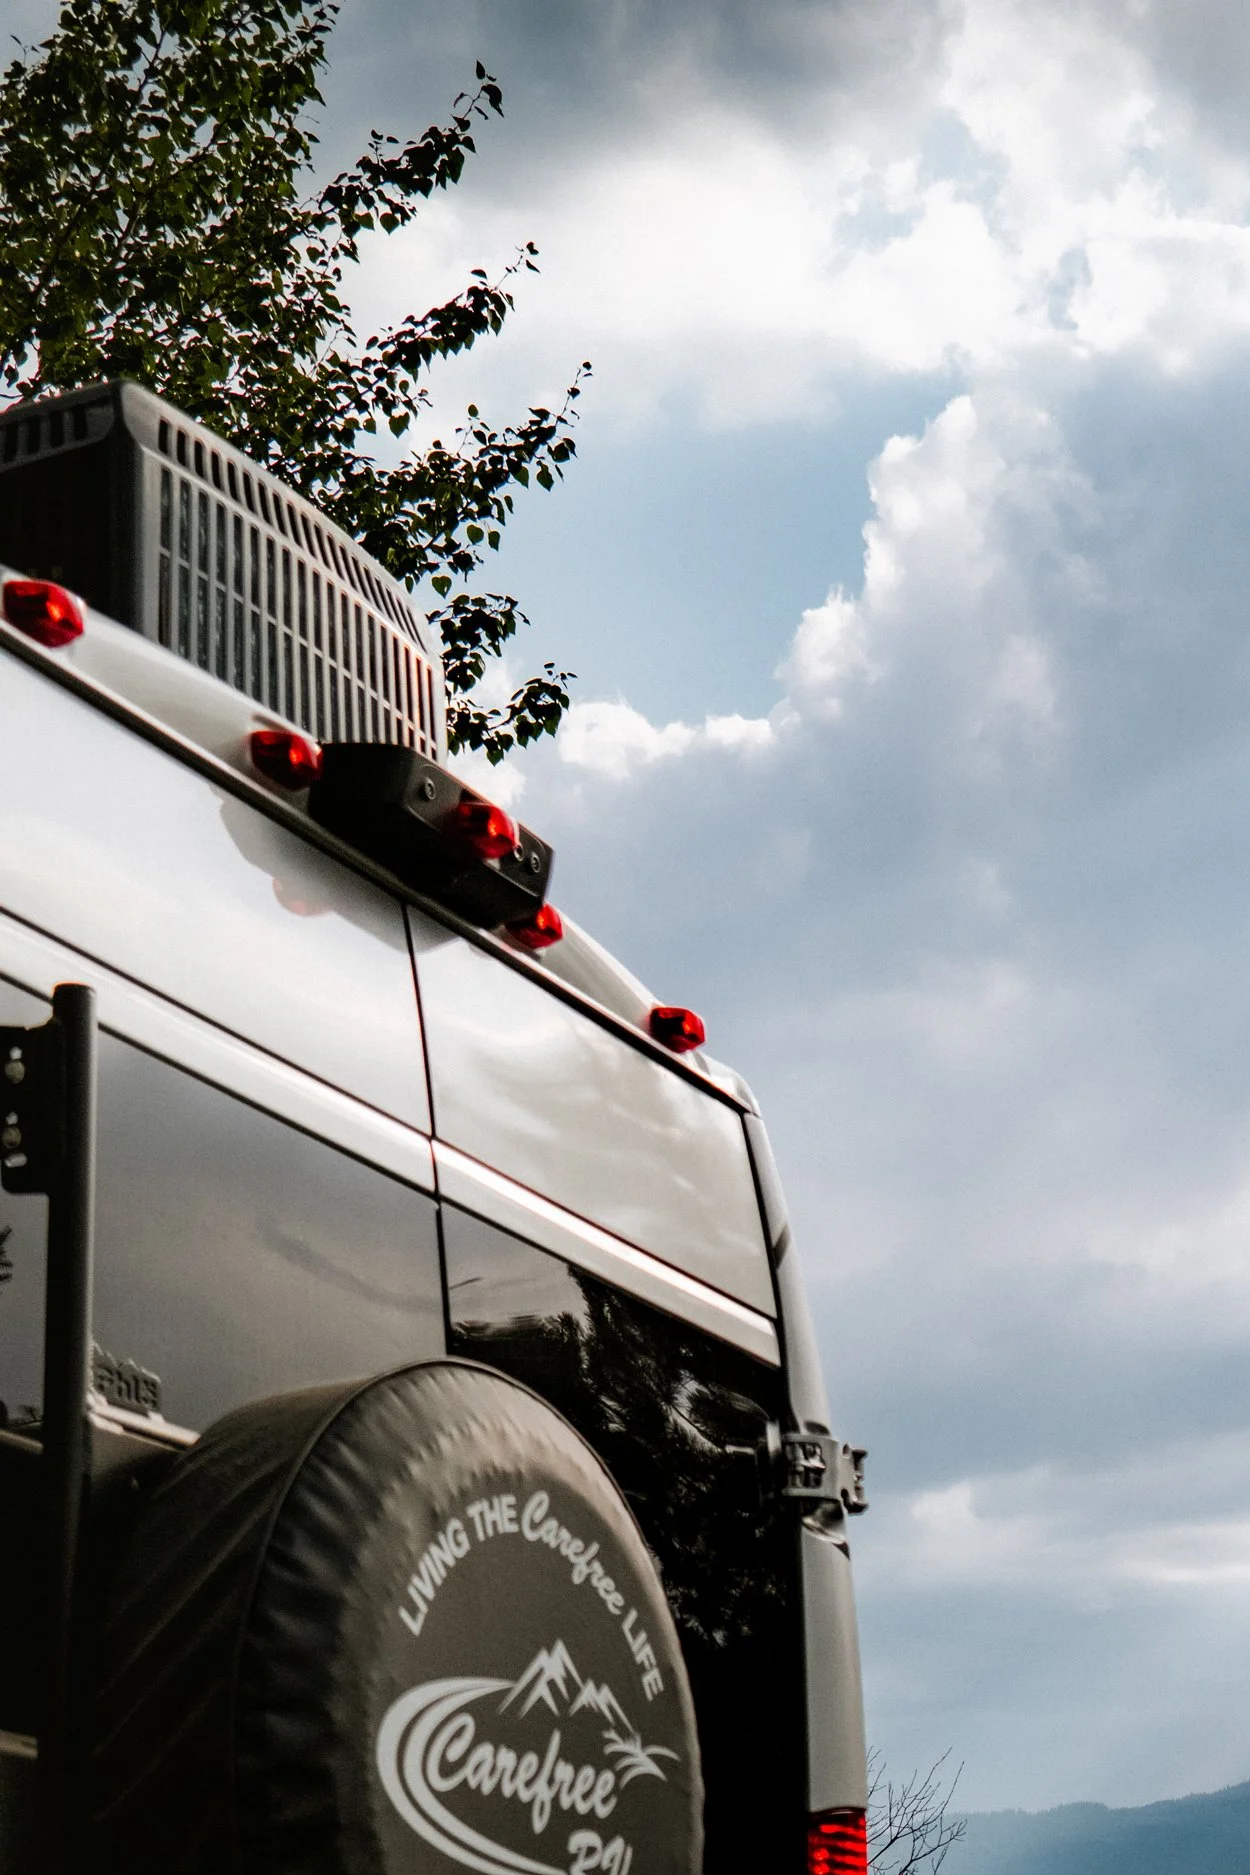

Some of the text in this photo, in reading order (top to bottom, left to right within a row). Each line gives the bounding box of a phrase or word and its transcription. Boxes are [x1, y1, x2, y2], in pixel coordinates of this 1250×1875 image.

[399, 1490, 665, 1701] LIVING THE Carefree LIFE
[427, 1712, 618, 1834] Carefree
